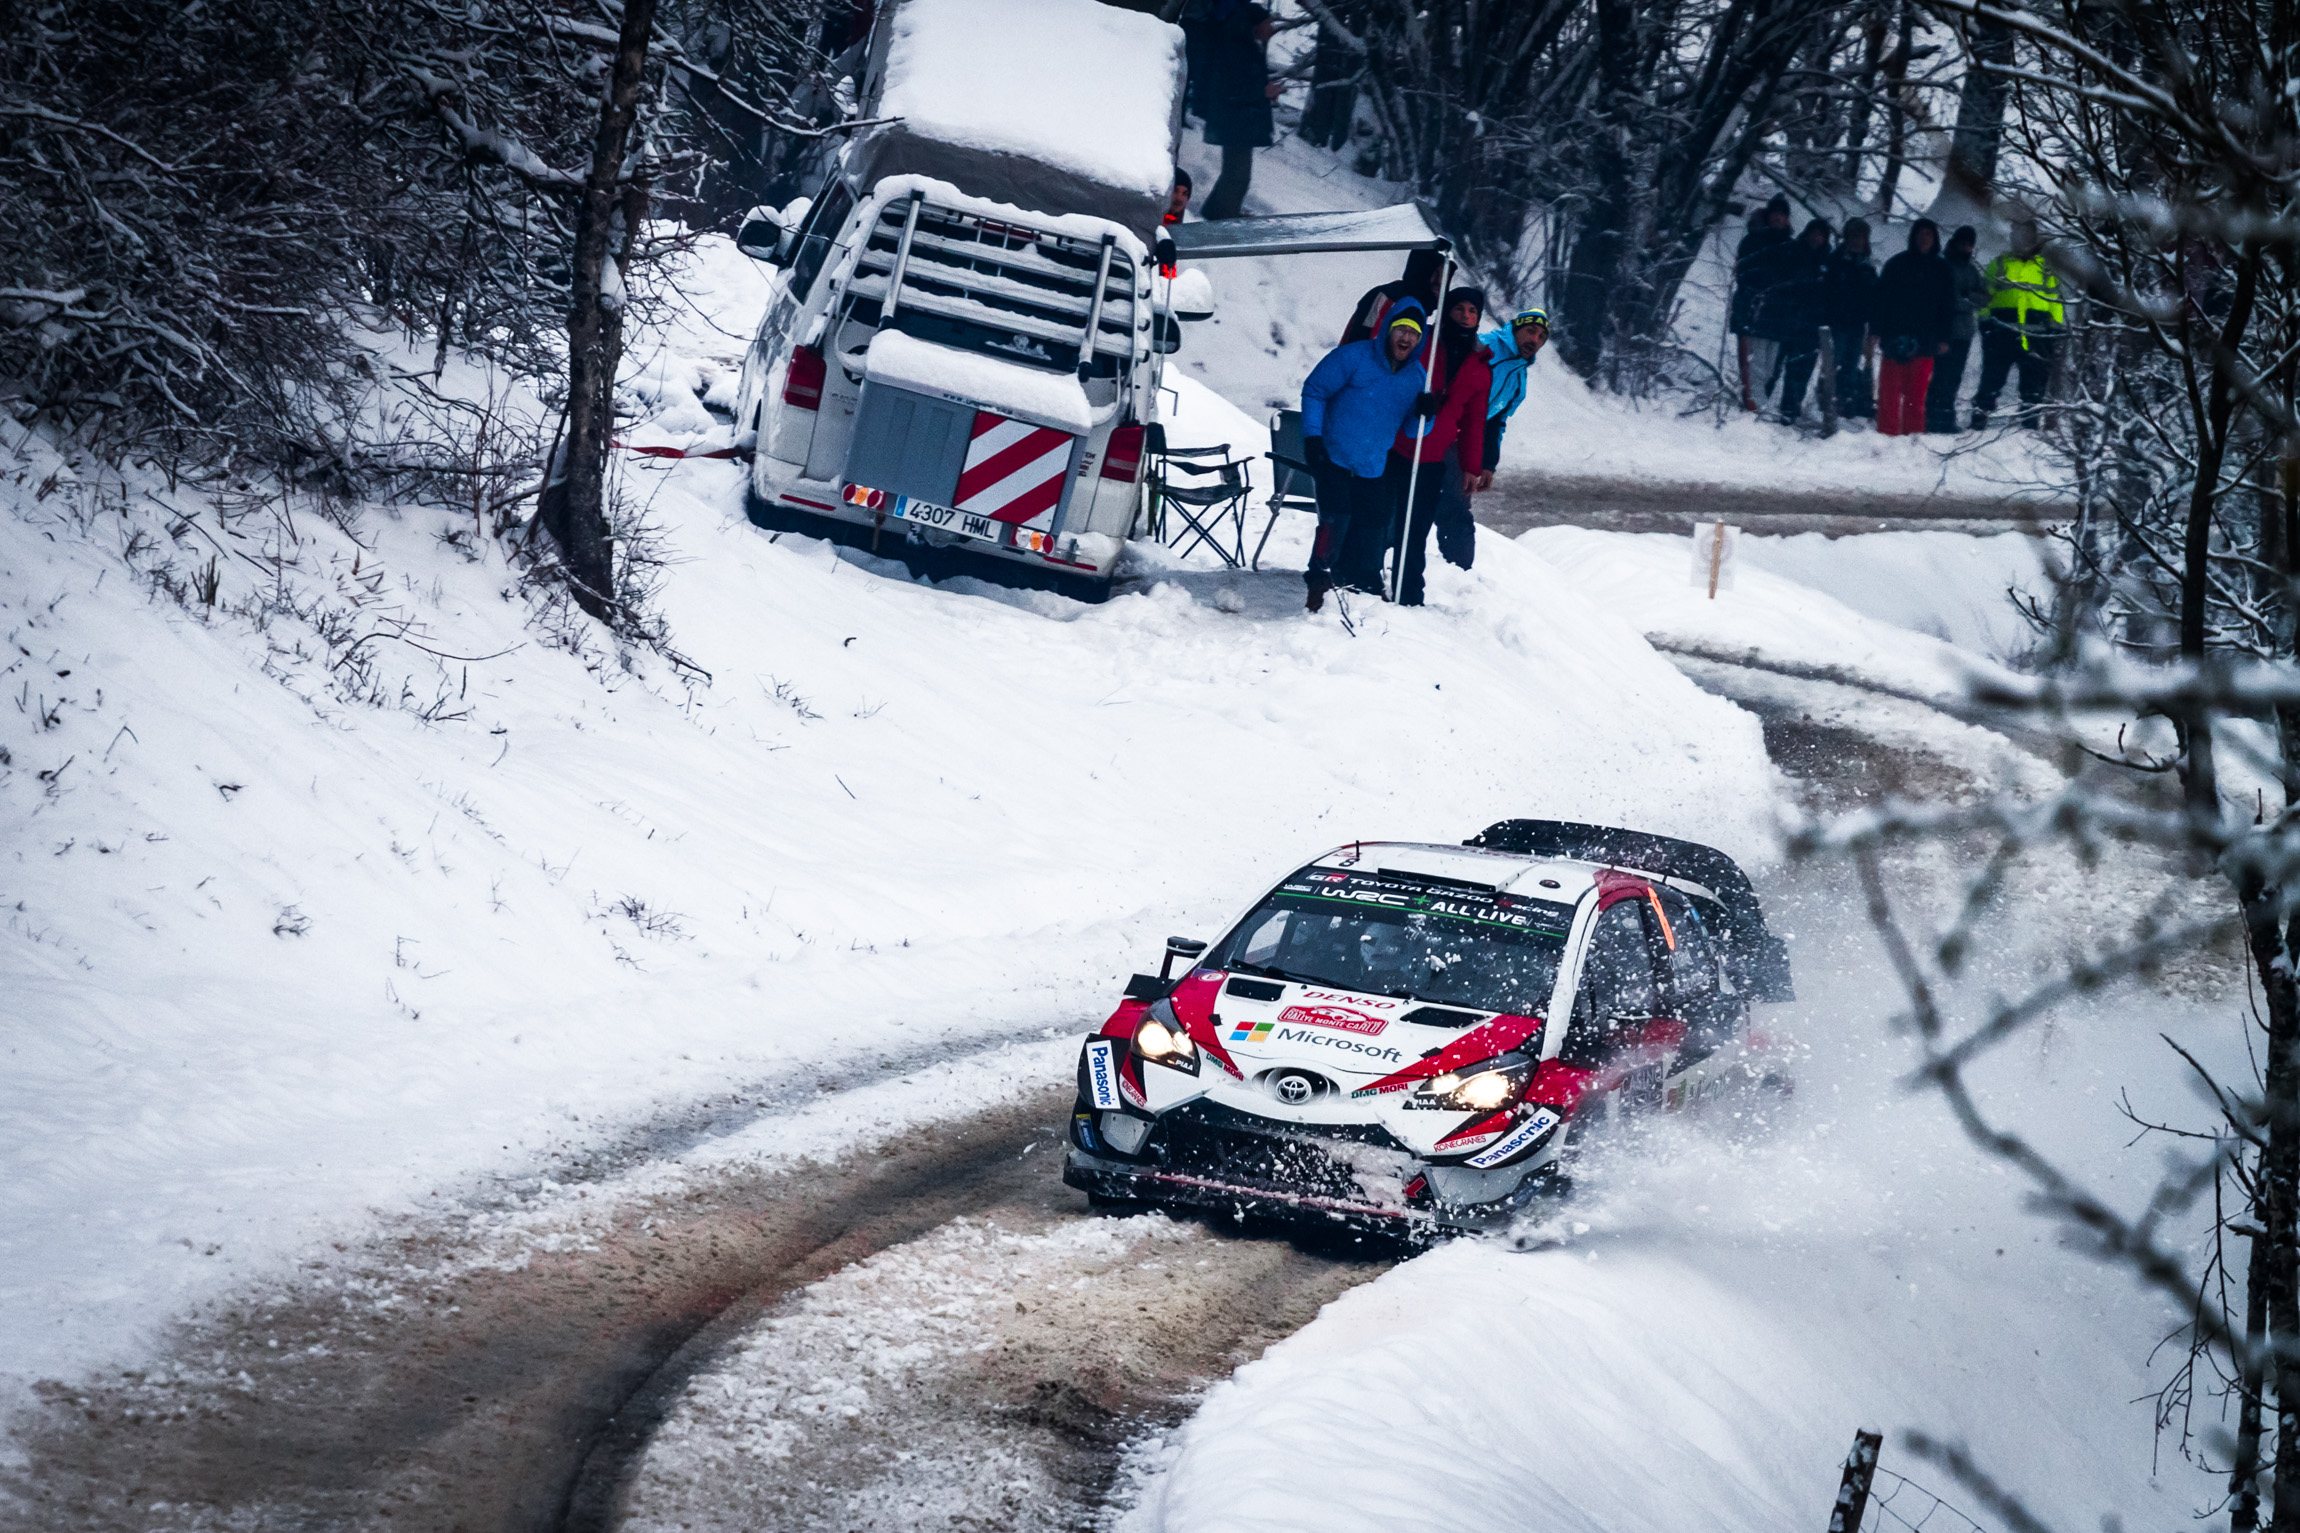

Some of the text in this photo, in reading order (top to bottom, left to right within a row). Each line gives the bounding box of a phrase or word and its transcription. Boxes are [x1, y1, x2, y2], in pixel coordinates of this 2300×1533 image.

[909, 502, 994, 539] 4307 HML
[1349, 877, 1422, 892] TOYOTA
[1426, 887, 1494, 904] GAZOO
[1430, 901, 1471, 917] ALL
[1304, 991, 1396, 1009] DENSO
[1284, 1010, 1314, 1023] RALLYE
[1277, 1028, 1403, 1063] Microsoft
[1092, 1046, 1115, 1106] Panasonic
[1175, 1059, 1194, 1071] PIAA
[1205, 1052, 1245, 1082] DMG MORI
[1351, 1083, 1408, 1100] DMG MORI
[1473, 1115, 1551, 1166] Panasonic
